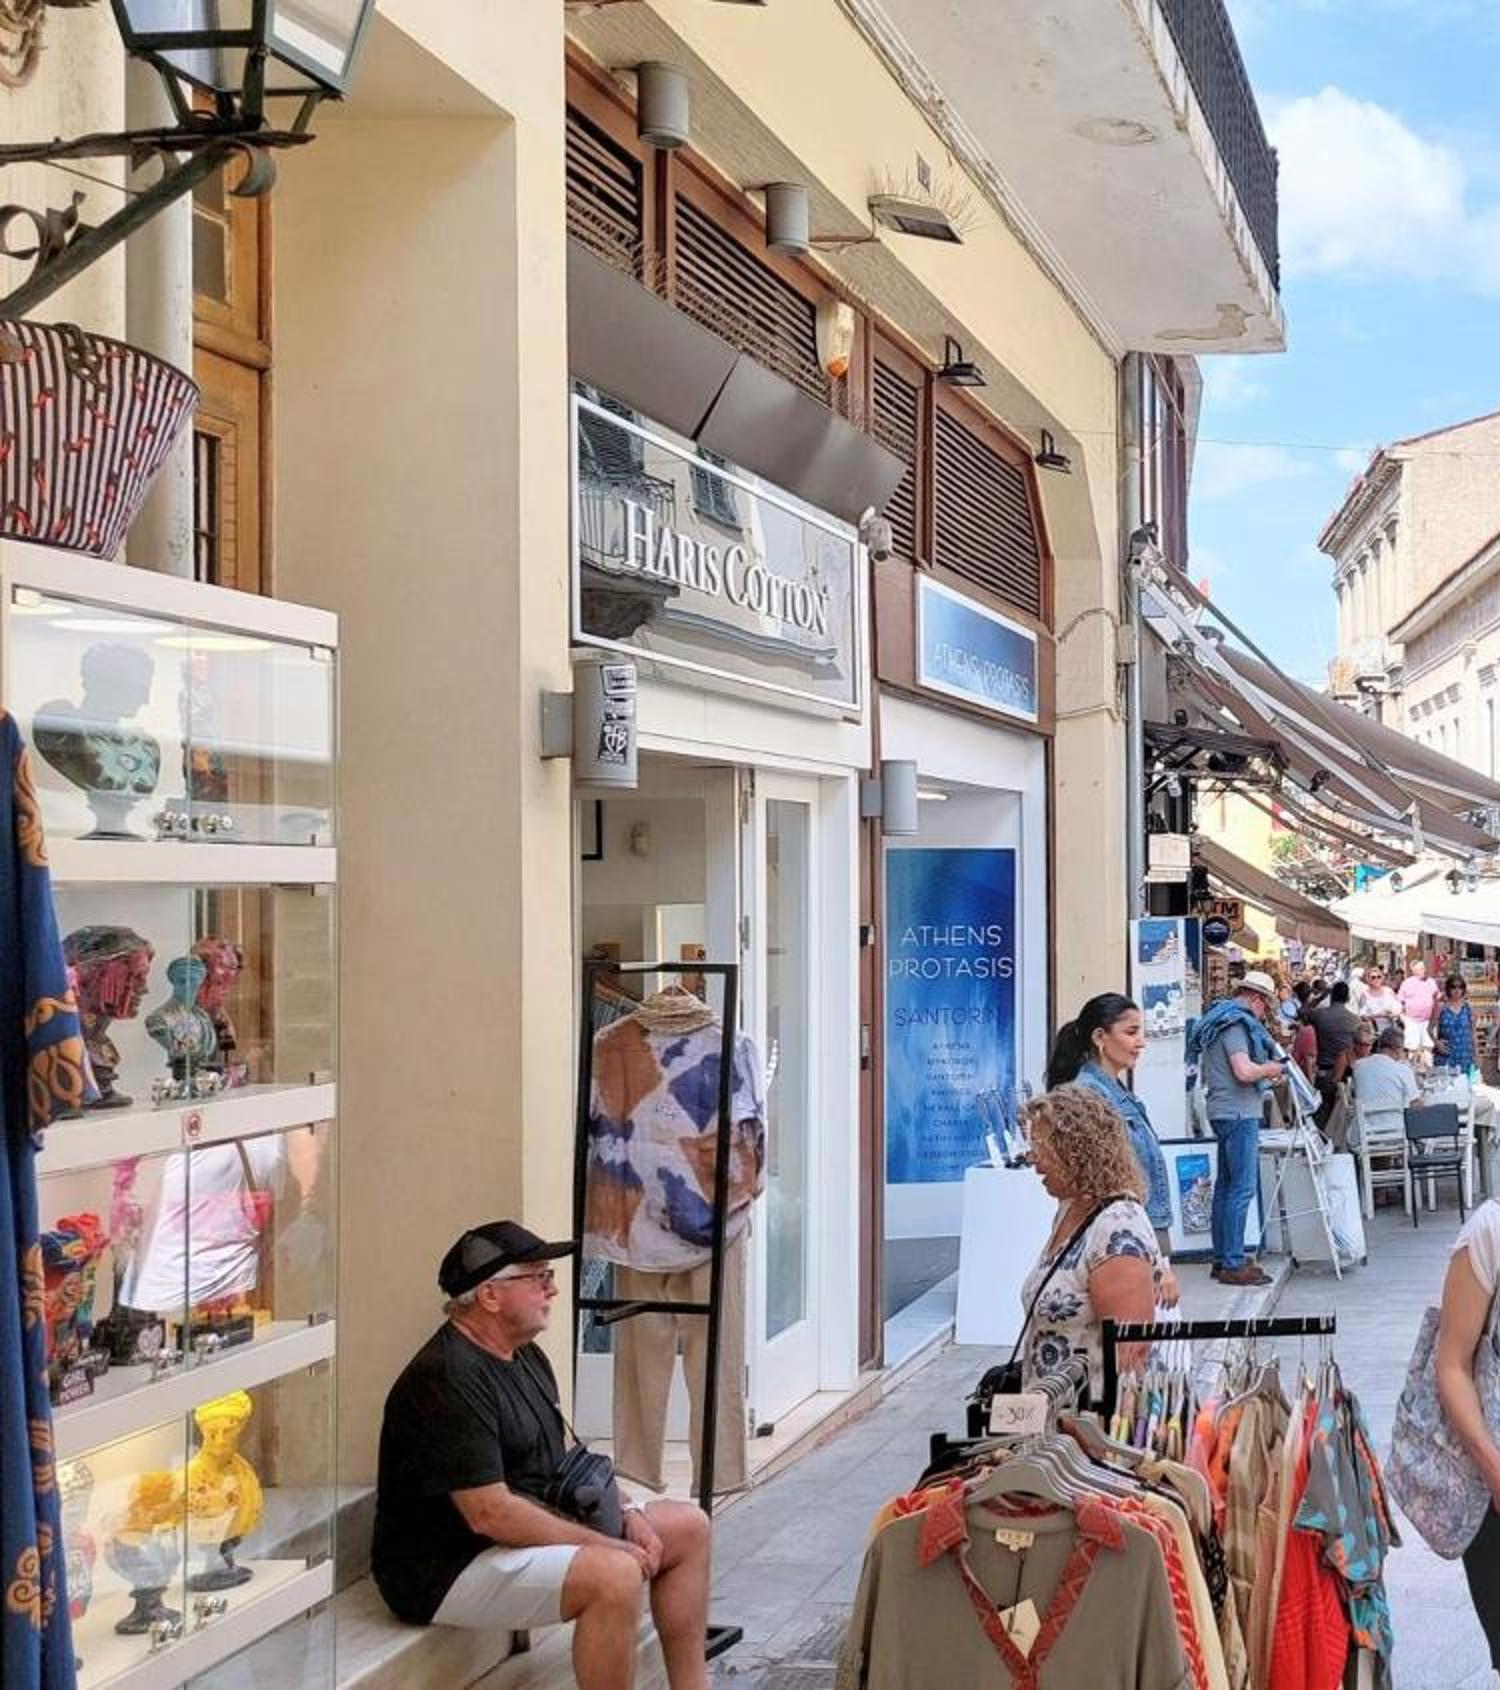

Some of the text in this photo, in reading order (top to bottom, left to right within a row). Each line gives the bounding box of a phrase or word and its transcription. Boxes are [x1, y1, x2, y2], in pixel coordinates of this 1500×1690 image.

[623, 499, 831, 635] HARIS COTTON
[900, 924, 1003, 947] ATHENS
[889, 957, 1014, 979] PROTASIS
